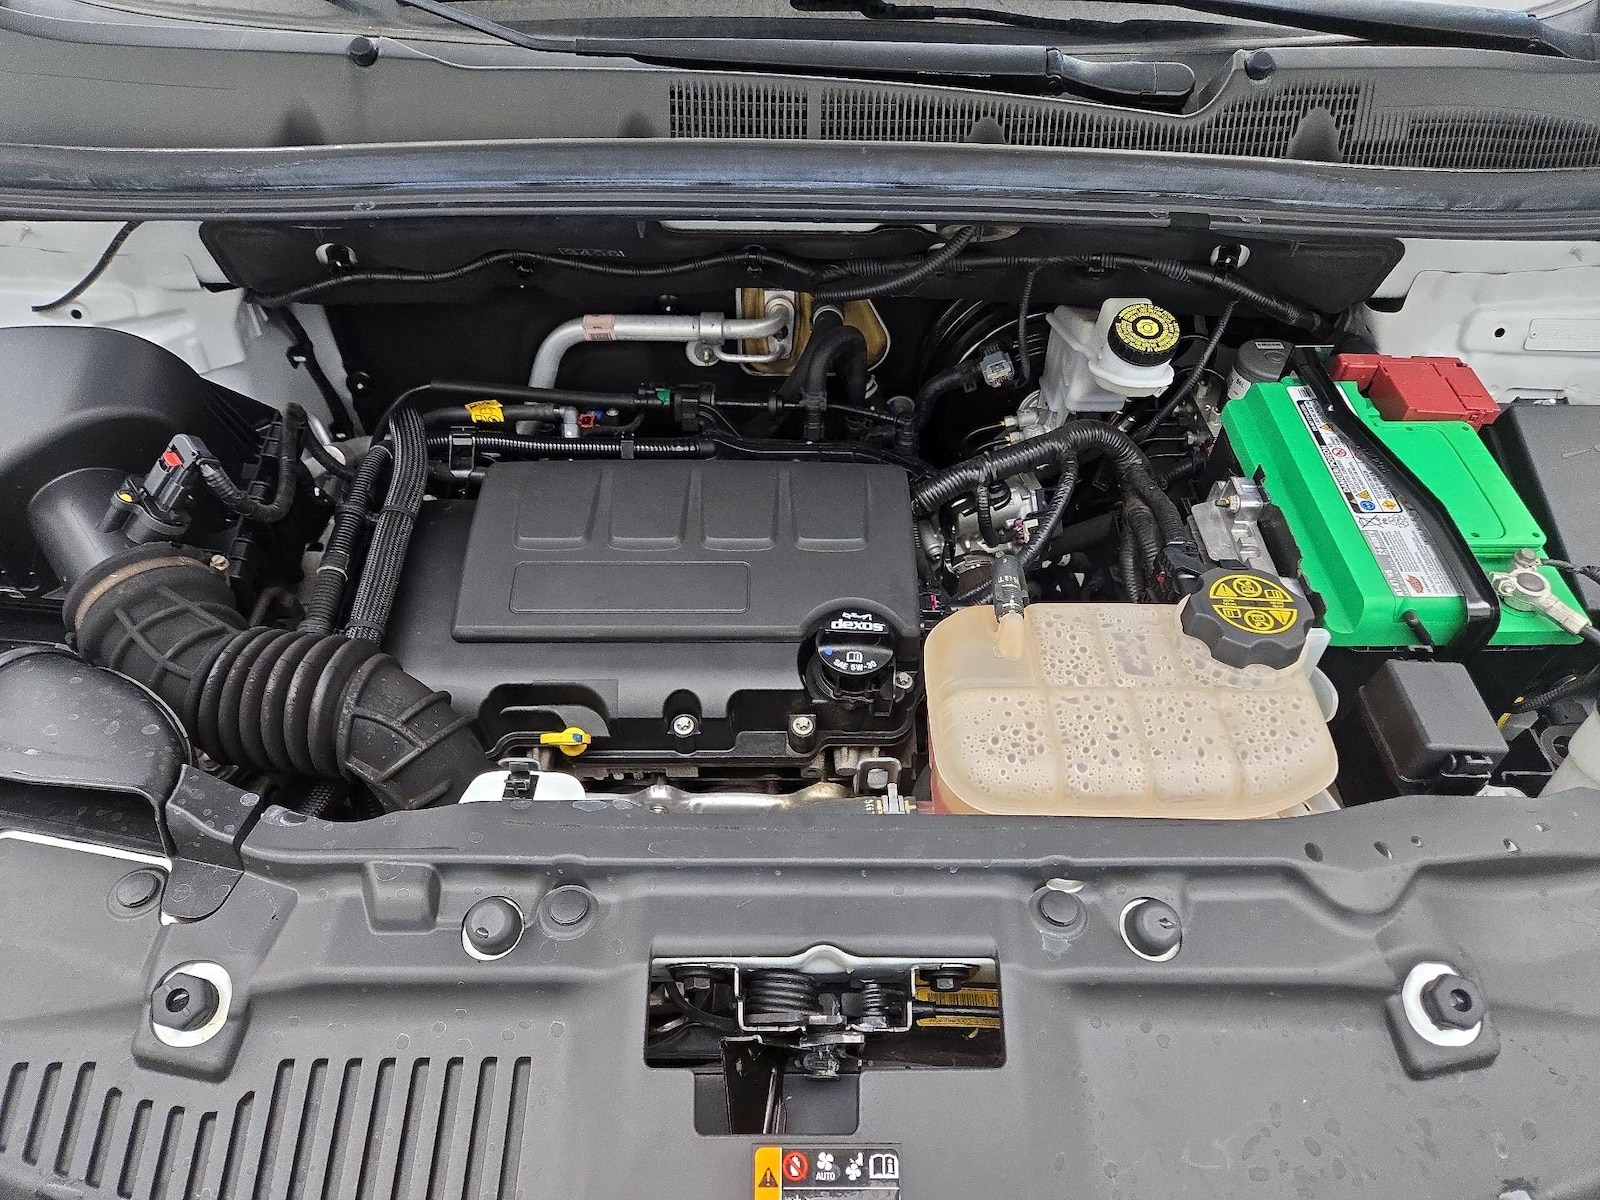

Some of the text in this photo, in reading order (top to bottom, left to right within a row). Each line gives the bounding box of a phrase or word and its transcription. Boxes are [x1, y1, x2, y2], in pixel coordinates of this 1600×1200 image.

[831, 619, 886, 631] dexos
[833, 658, 877, 671] SAE 5W-30
[815, 1171, 836, 1180] AUTO
